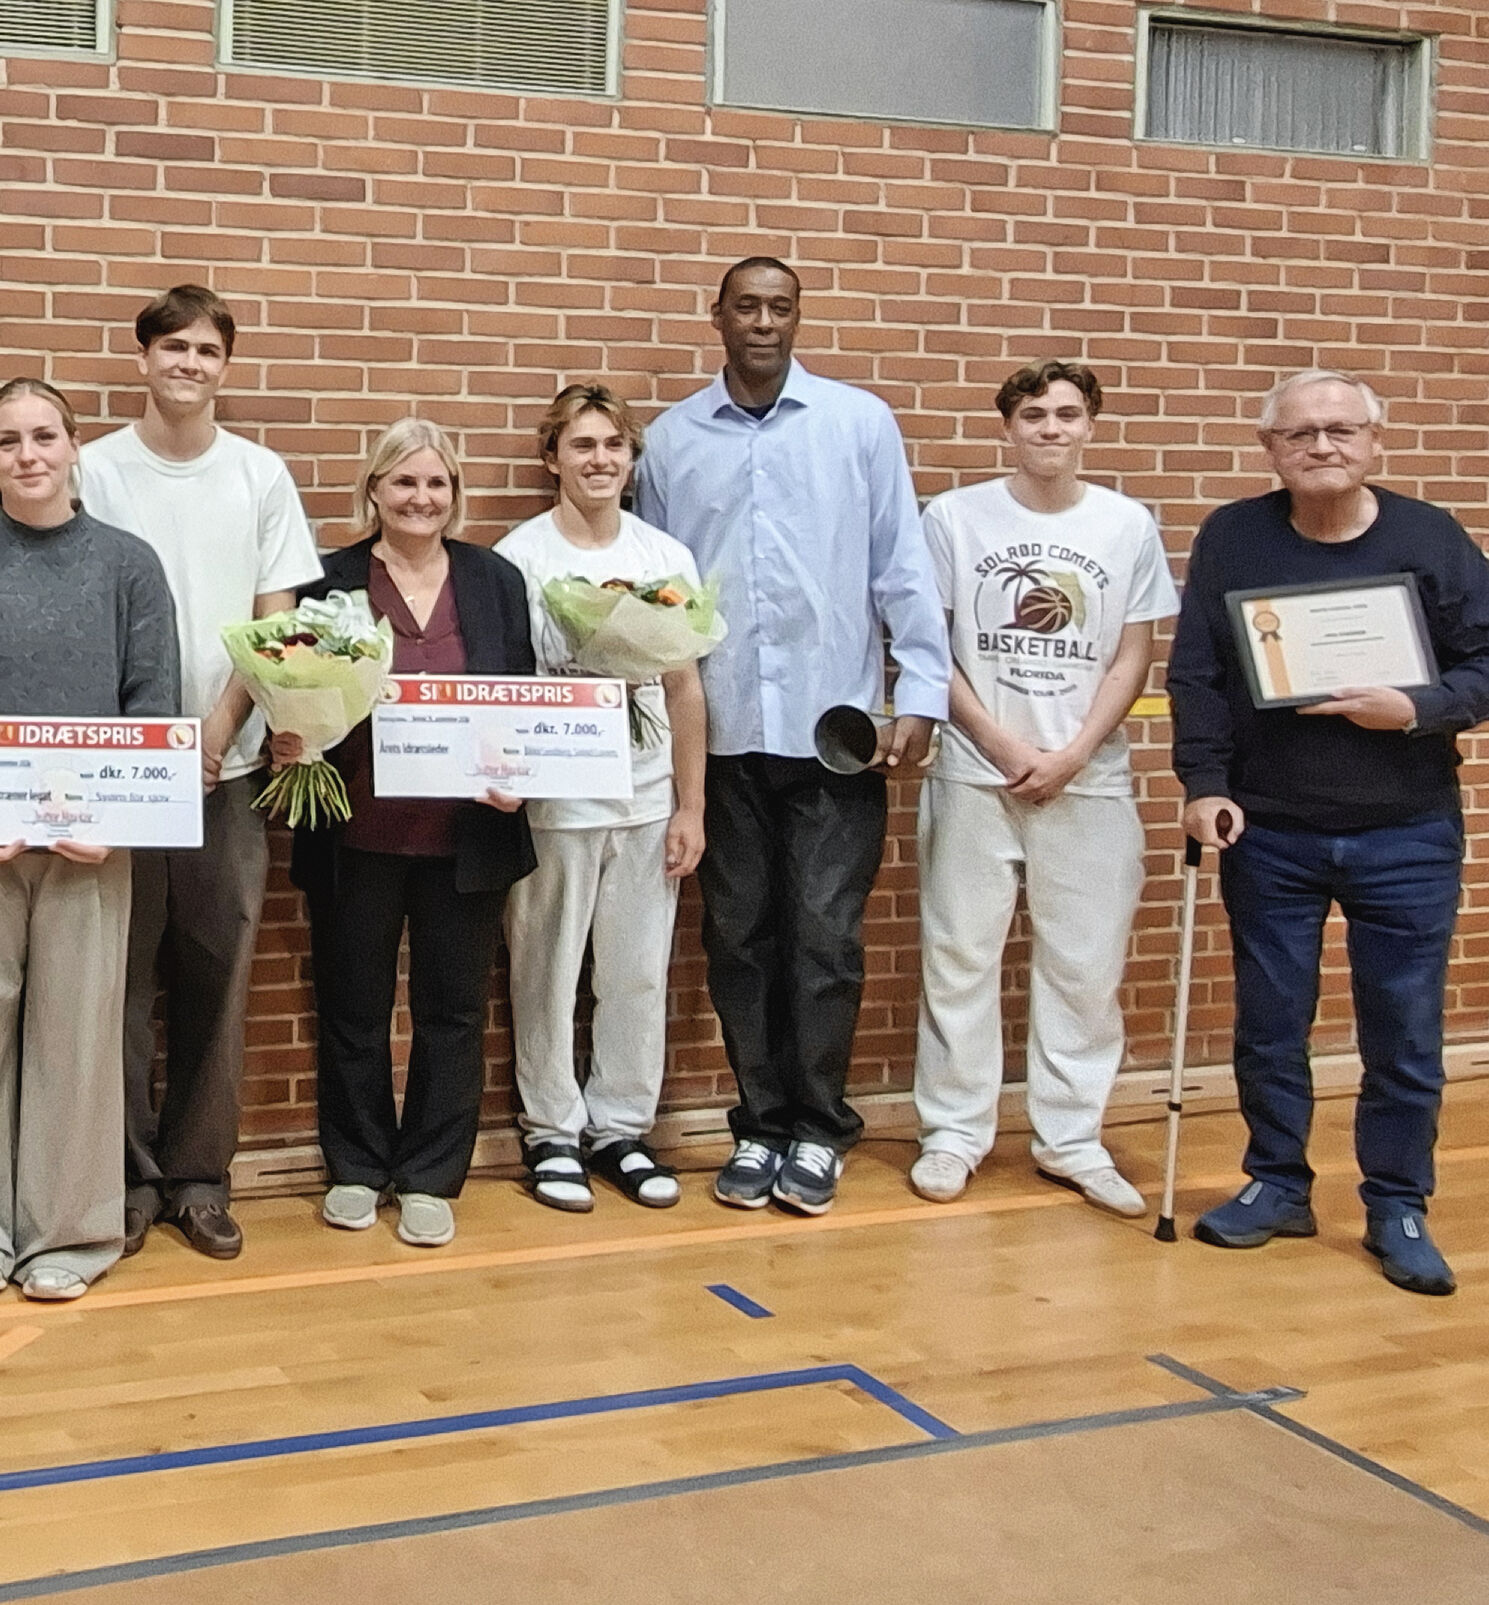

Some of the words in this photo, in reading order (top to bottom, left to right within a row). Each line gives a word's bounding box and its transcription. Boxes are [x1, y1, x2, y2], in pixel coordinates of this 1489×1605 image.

[1047, 544, 1110, 591] COMETS
[1009, 667, 1066, 681] FLORIDA
[456, 683, 574, 704] IDRÆTSPRIS
[18, 725, 145, 745] IDRÆTSPRIS
[99, 765, 125, 779] dkr.
